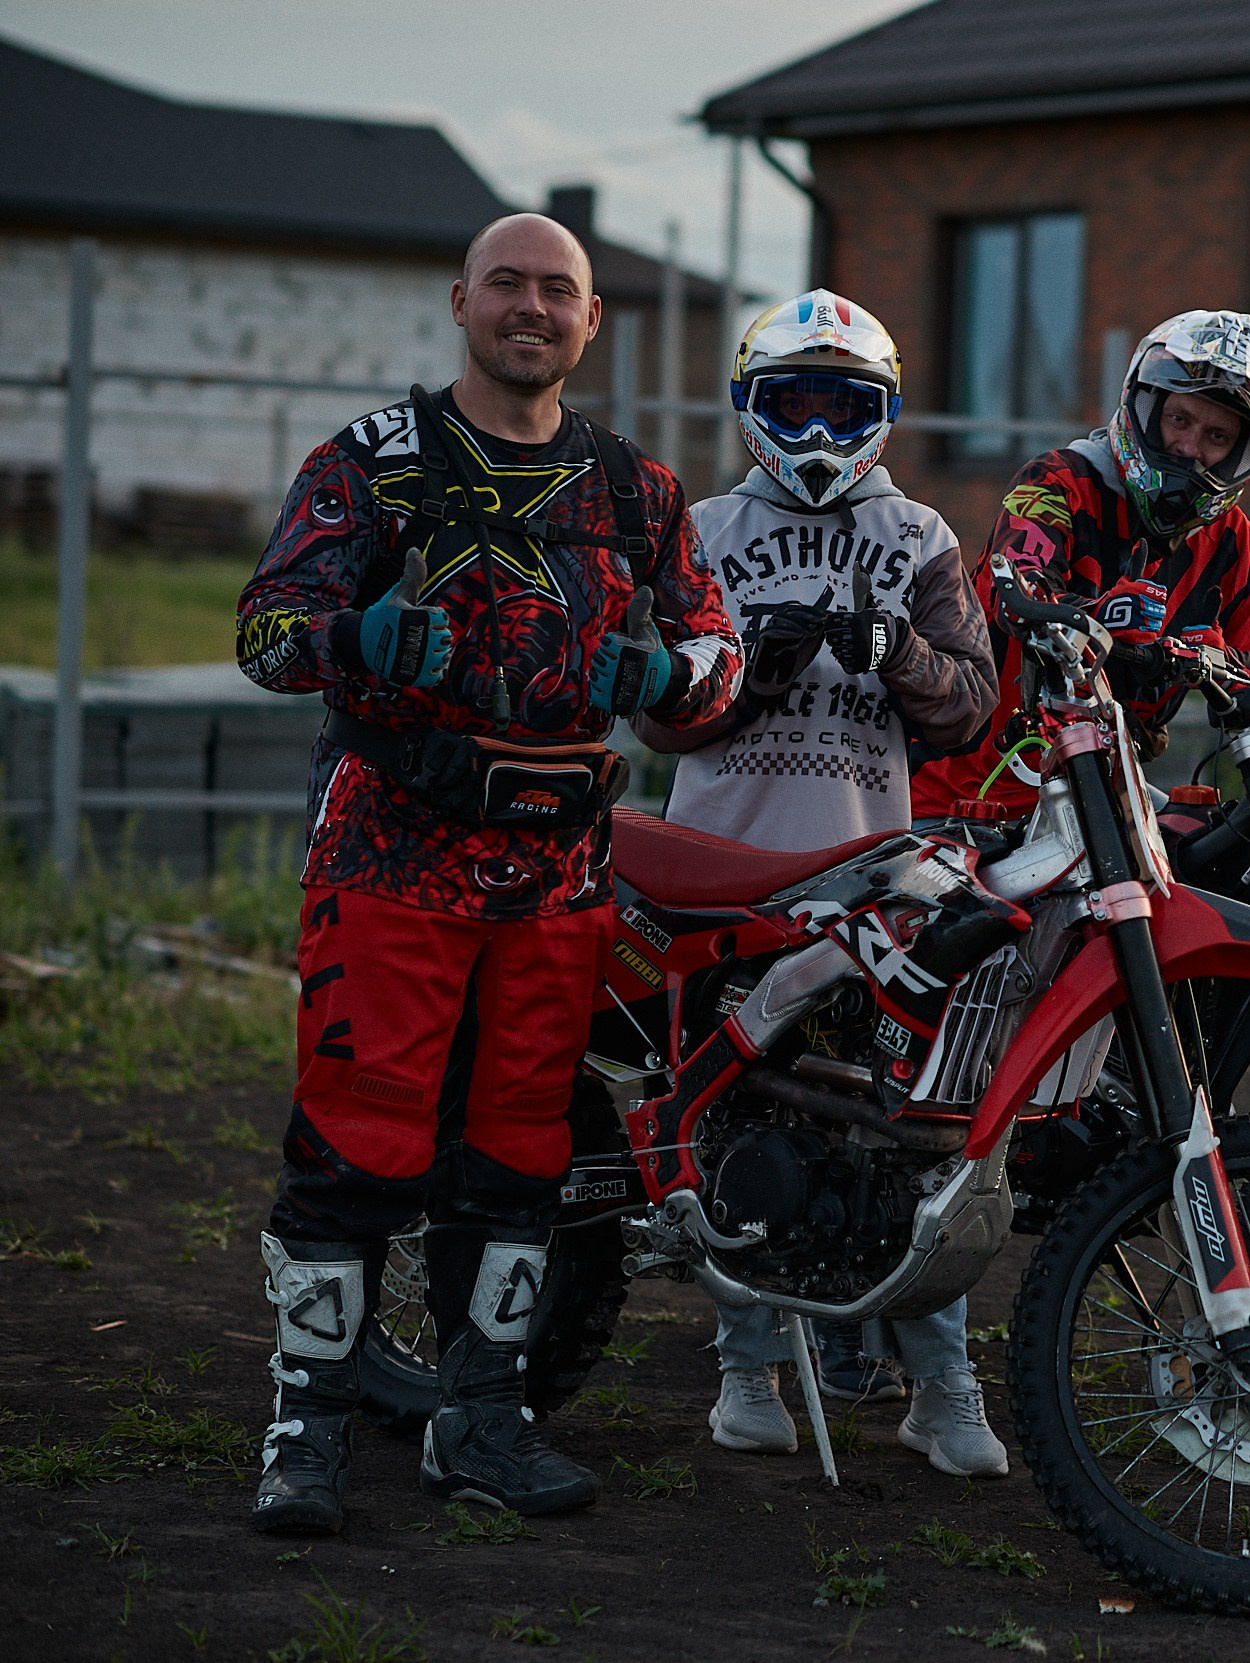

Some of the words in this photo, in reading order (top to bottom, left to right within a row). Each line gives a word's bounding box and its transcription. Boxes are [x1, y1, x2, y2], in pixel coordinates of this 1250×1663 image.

[754, 437, 781, 476] Bull
[711, 526, 917, 612] ASTHOUS
[774, 573, 799, 588] AND
[827, 574, 849, 590] LET
[871, 625, 889, 669] 100%
[730, 731, 805, 745] MOTO
[818, 732, 888, 757] CREW
[510, 801, 559, 814] RACING
[630, 911, 673, 953] IPONE
[575, 1179, 627, 1201] IPONE
